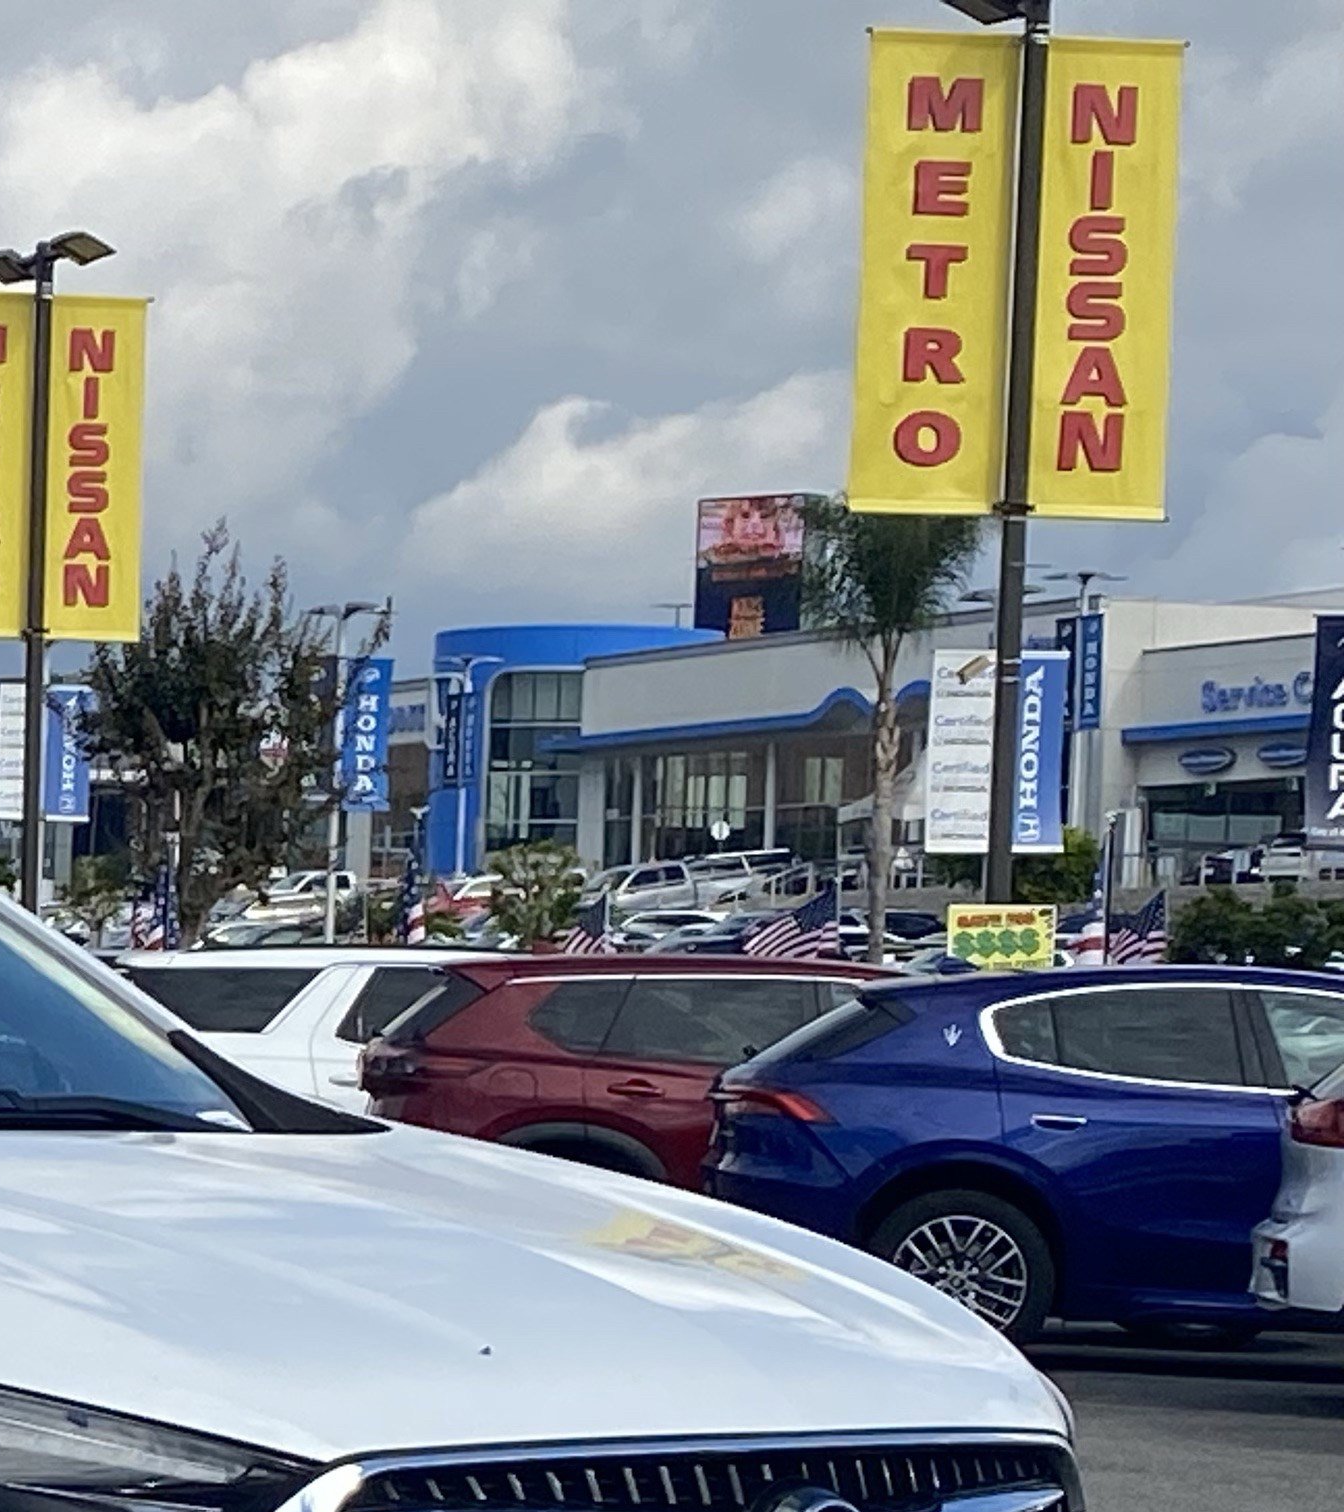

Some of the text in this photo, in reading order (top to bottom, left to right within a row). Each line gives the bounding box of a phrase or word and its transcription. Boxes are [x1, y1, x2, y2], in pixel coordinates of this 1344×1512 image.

[892, 75, 985, 468] METRO
[1056, 82, 1139, 473] NISSAN
[62, 327, 116, 608] NISSAN
[61, 695, 79, 792] HON
[353, 694, 379, 793] HONDA
[1018, 665, 1045, 811] HONDA
[1081, 641, 1099, 717] HONDA
